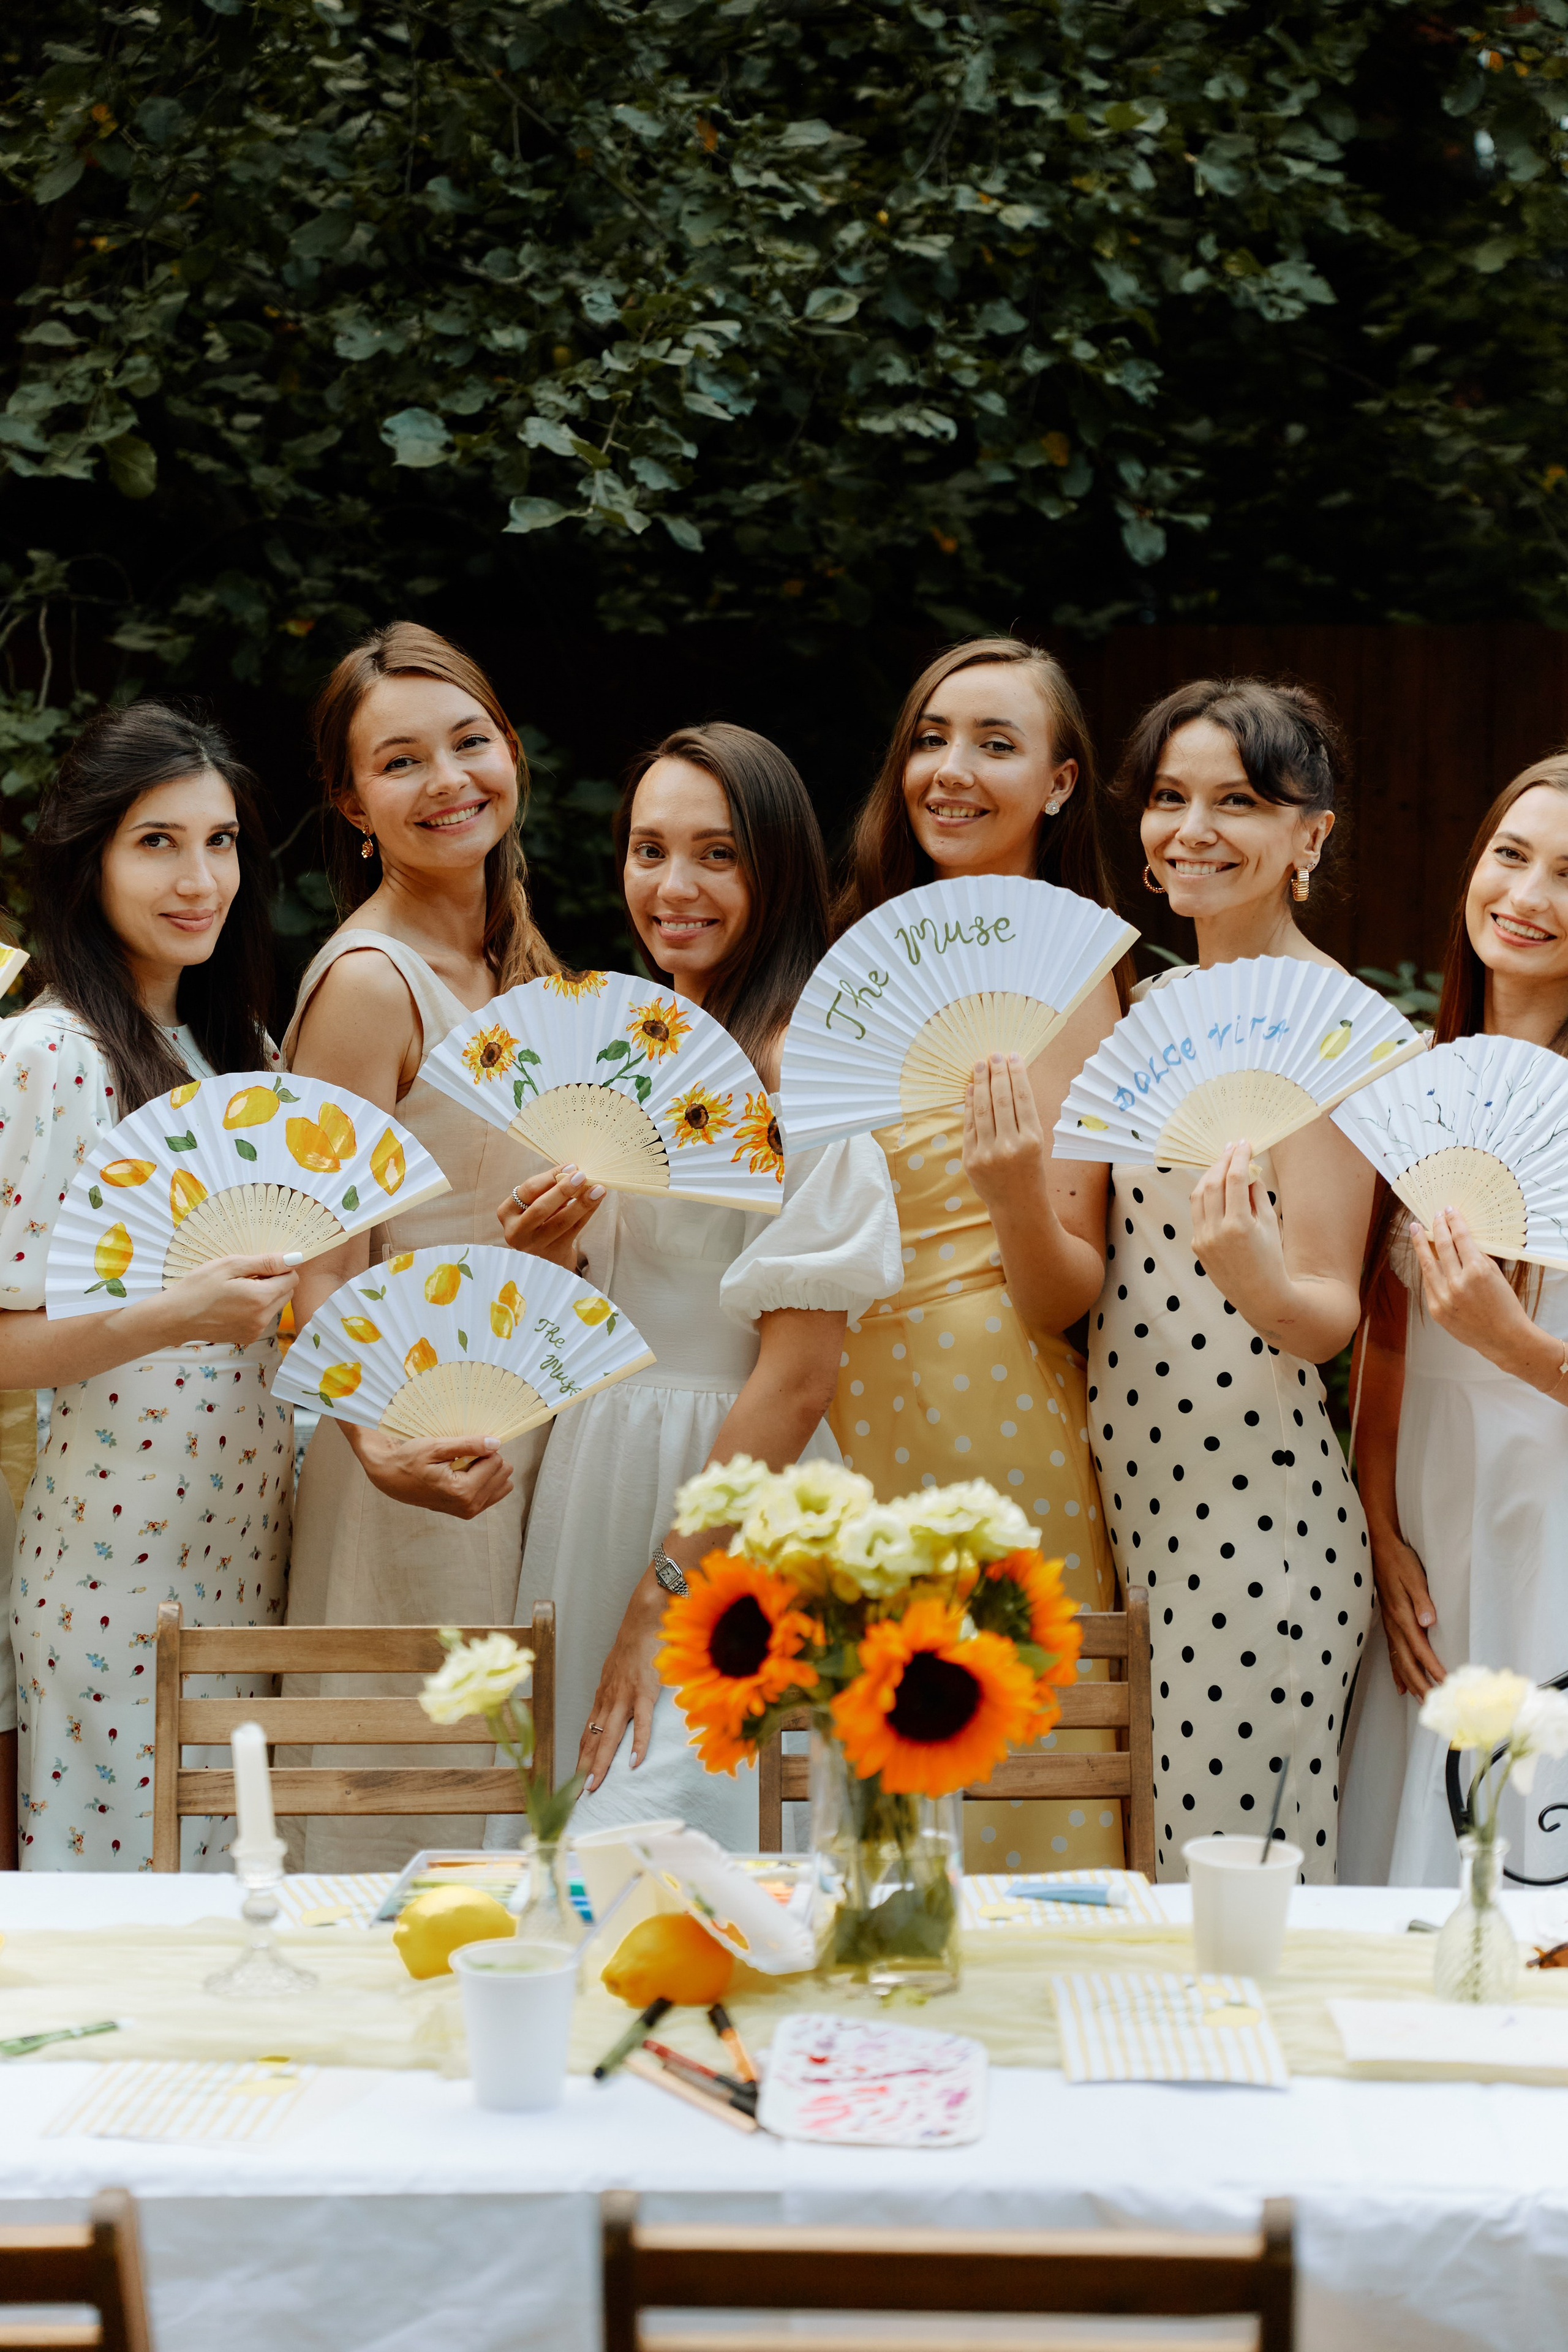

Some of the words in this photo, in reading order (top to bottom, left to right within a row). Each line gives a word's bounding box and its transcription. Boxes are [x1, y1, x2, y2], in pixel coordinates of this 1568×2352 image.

[825, 970, 889, 1040] The
[894, 916, 1016, 965] Muse
[534, 1319, 565, 1348] The
